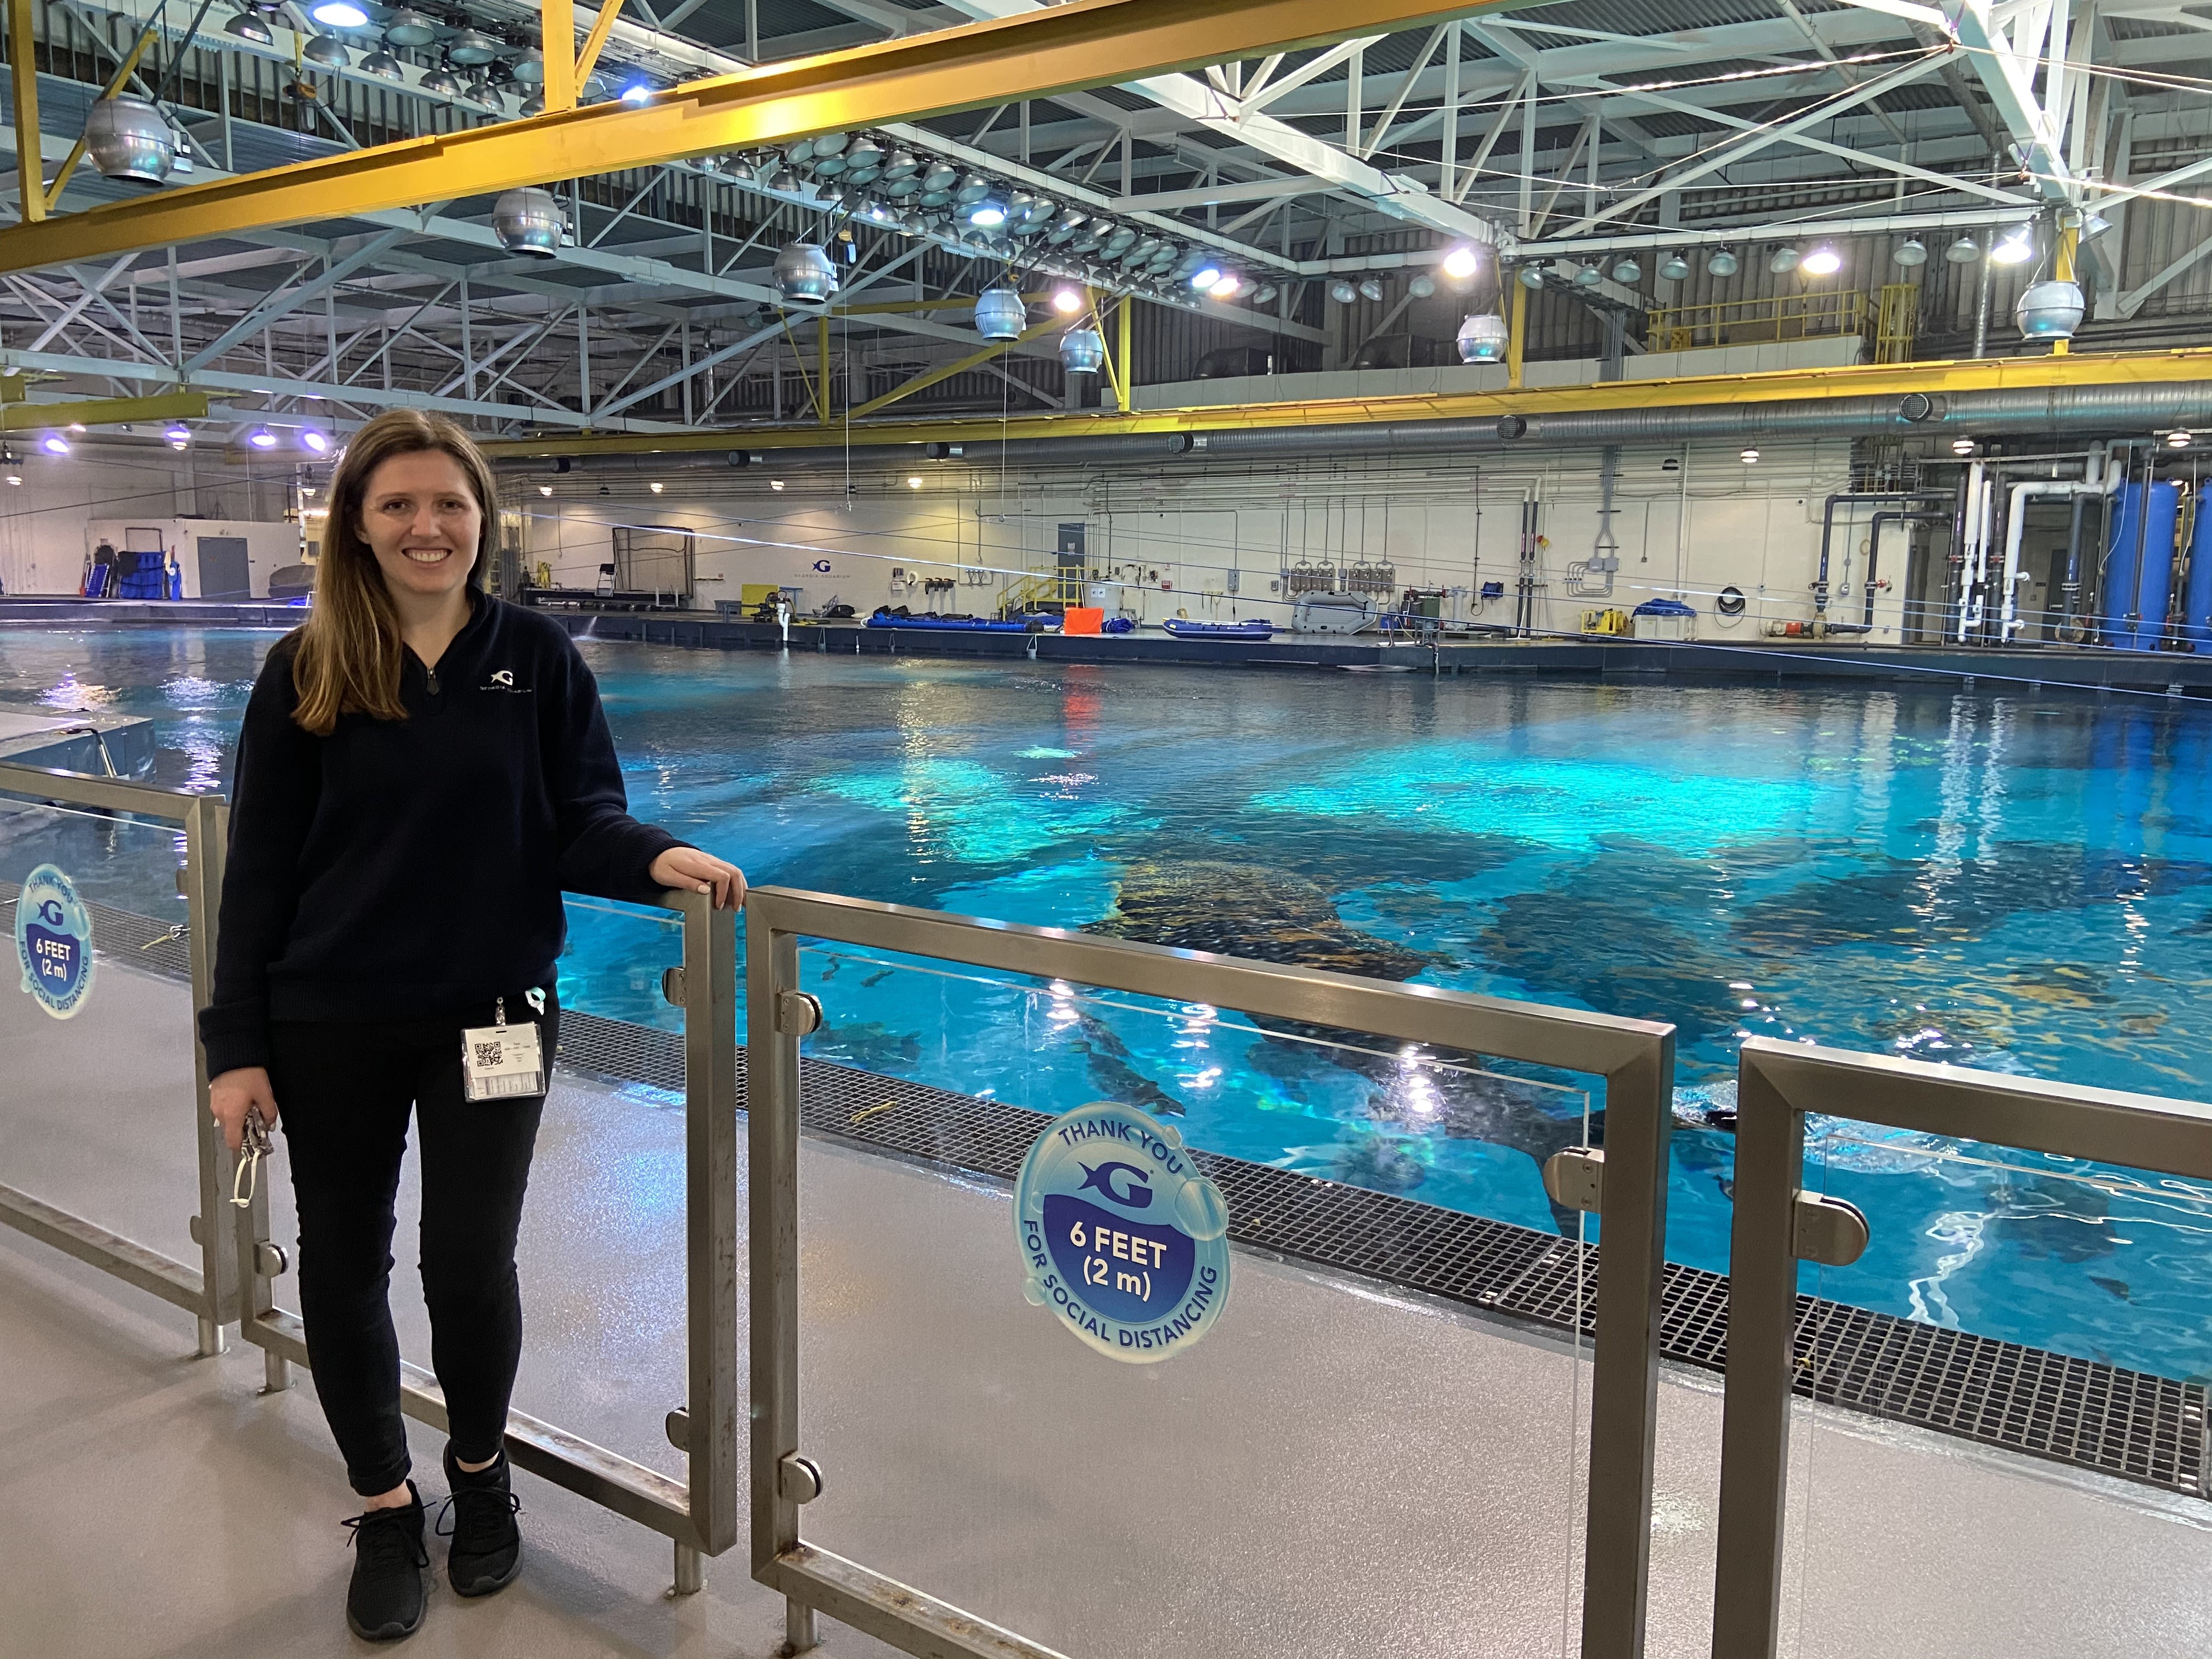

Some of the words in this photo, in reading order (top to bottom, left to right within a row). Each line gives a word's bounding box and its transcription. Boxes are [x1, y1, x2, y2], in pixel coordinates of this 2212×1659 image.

[29, 876, 55, 893] THANK
[56, 881, 74, 904] YOU
[36, 938, 43, 954] 6
[44, 940, 71, 961] FEET
[42, 958, 52, 977] (2
[54, 962, 67, 982] m)
[19, 940, 31, 971] FOR
[29, 973, 55, 1009] SOCIAL
[57, 956, 89, 1011] DISTANCING
[1058, 1120, 1132, 1147] THANK
[1141, 1131, 1184, 1175] YOU
[1070, 1221, 1086, 1247] 6
[1095, 1226, 1167, 1269] FEET
[1024, 1220, 1047, 1269] FOR
[1043, 1273, 1110, 1342] SOCIAL
[1119, 1265, 1217, 1349] DISTANCING
[1083, 1255, 1108, 1286] (2
[1117, 1271, 1151, 1302] m)
